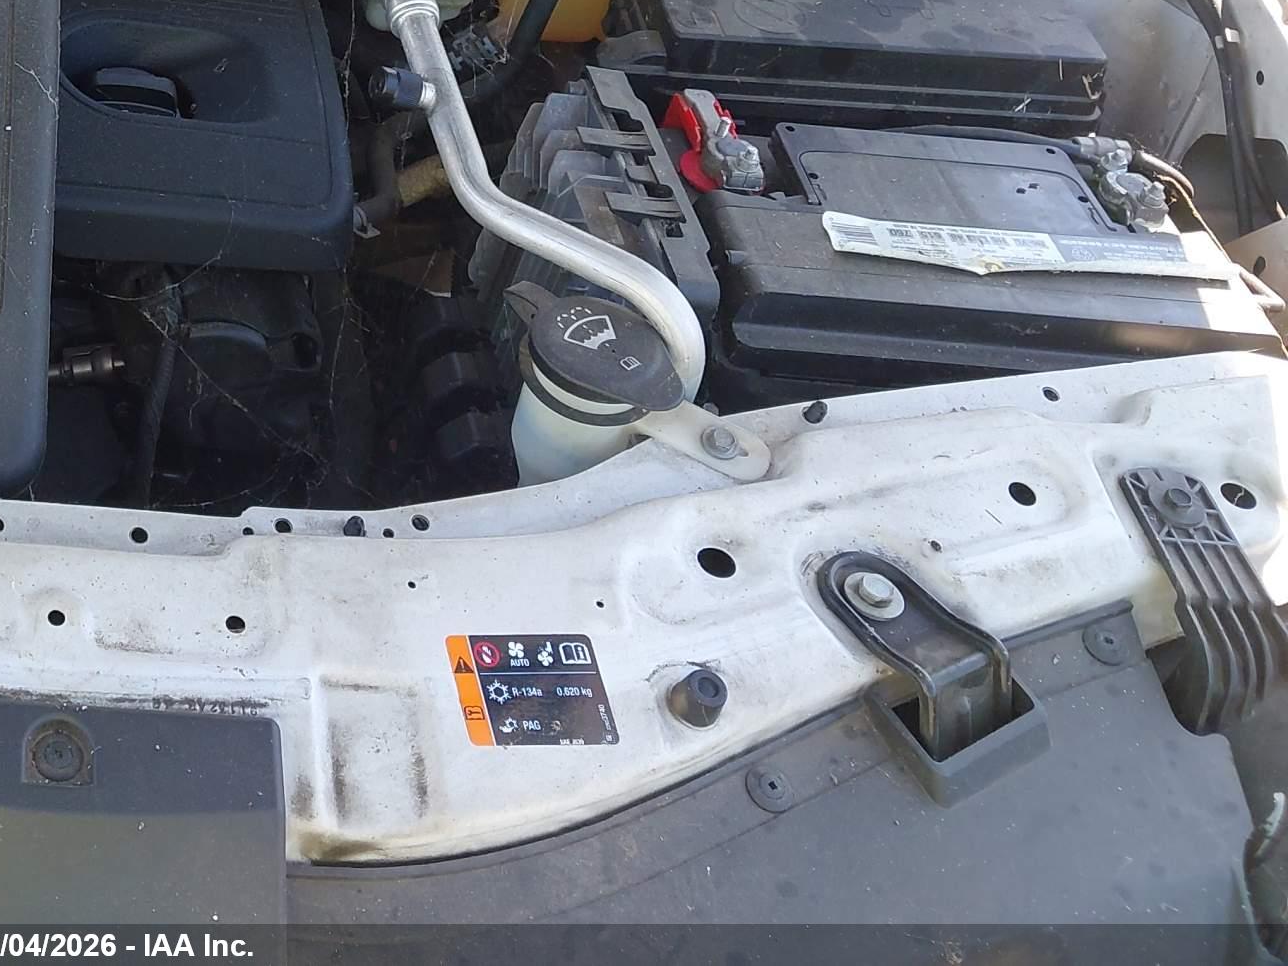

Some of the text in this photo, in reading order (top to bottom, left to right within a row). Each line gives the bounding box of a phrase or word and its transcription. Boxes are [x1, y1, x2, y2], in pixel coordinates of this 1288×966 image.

[510, 658, 530, 667] AUTO
[512, 687, 543, 697] R-134a
[581, 687, 593, 698] kg
[522, 720, 541, 731] PAG
